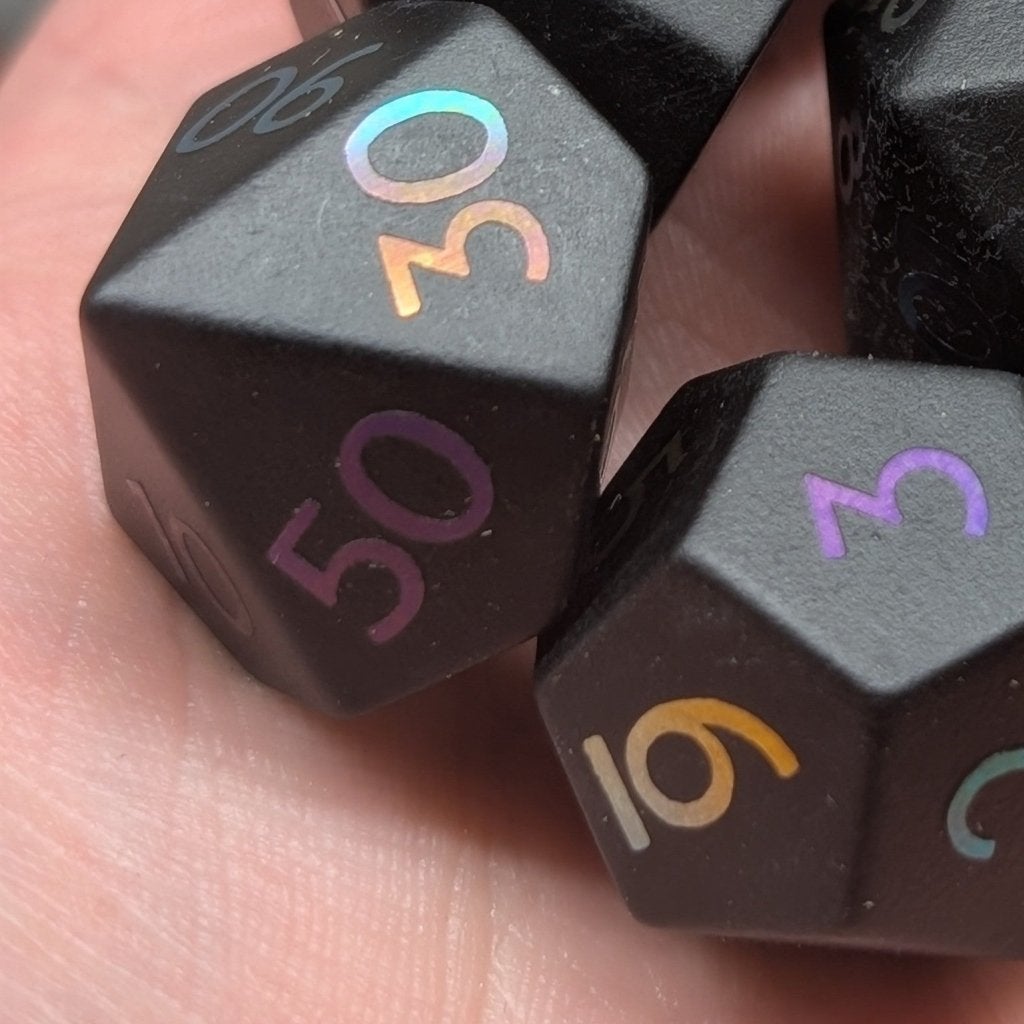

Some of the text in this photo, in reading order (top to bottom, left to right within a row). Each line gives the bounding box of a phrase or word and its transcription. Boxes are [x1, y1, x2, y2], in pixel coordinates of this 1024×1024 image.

[344, 88, 549, 317] 30
[267, 409, 494, 644] 50
[804, 447, 989, 559] 3
